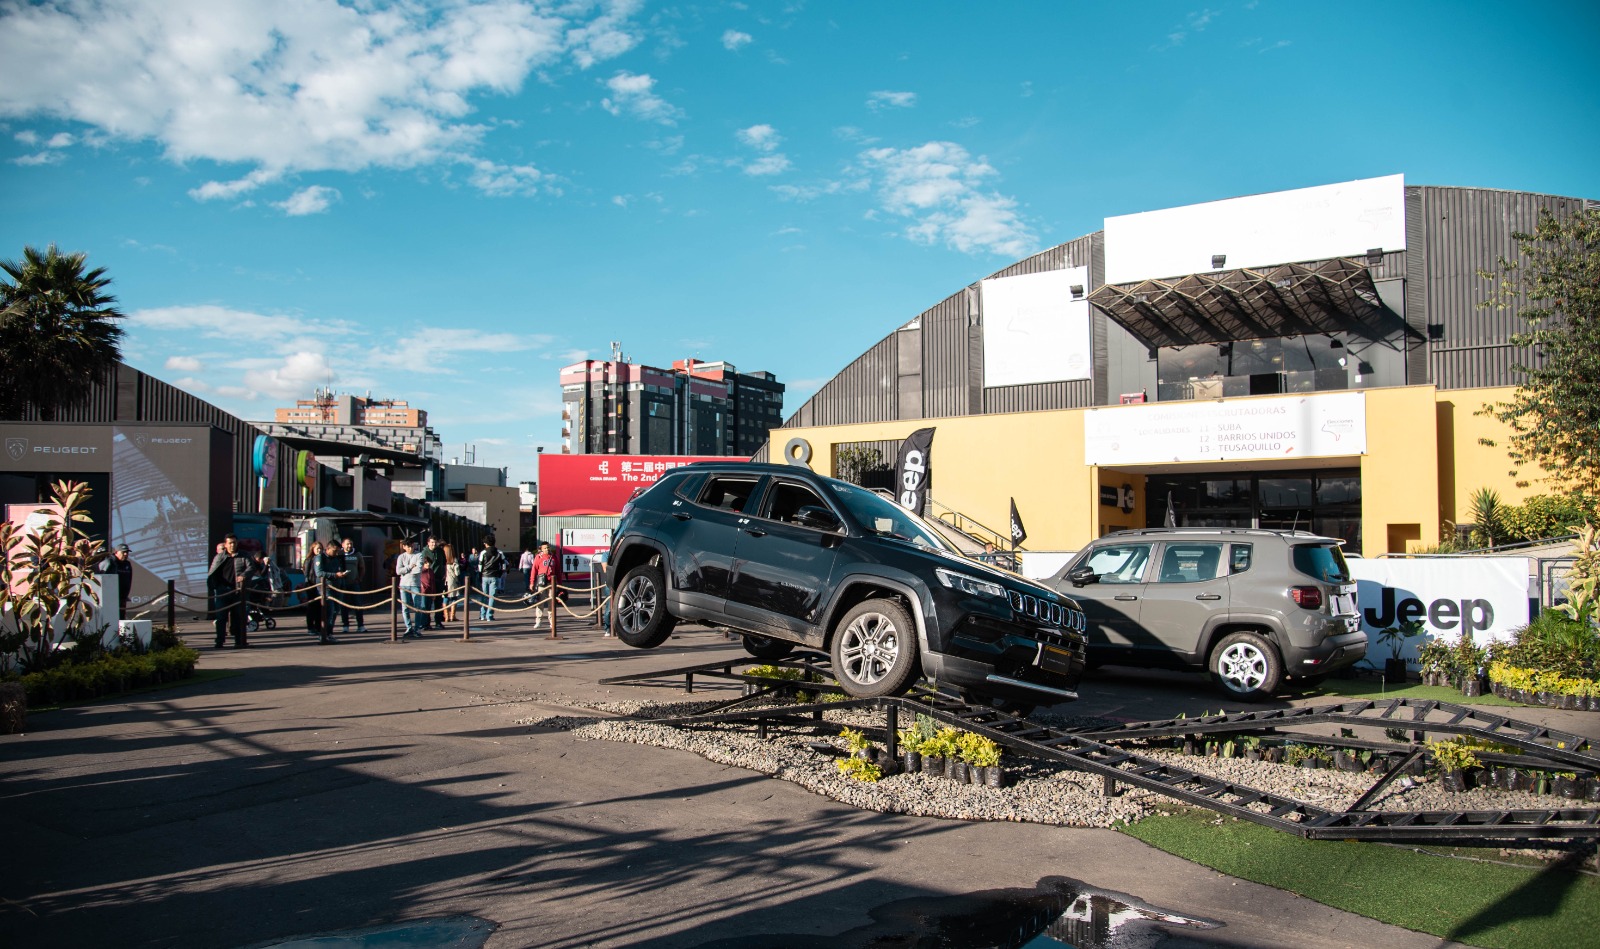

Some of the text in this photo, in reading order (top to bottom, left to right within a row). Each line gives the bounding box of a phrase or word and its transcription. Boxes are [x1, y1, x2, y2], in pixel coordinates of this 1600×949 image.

[1217, 423, 1242, 431] SUBA
[1200, 435, 1210, 443] 12
[1217, 433, 1256, 442] BARRIOS
[1259, 431, 1296, 440] UNIDOS
[33, 446, 98, 454] PEUGEOT
[1200, 445, 1210, 453] 13
[1218, 443, 1281, 453] TEUSAQUILLO
[621, 473, 638, 482] The
[640, 473, 658, 482] 2nd
[901, 450, 926, 511] eep
[1364, 587, 1495, 640] Jeep
